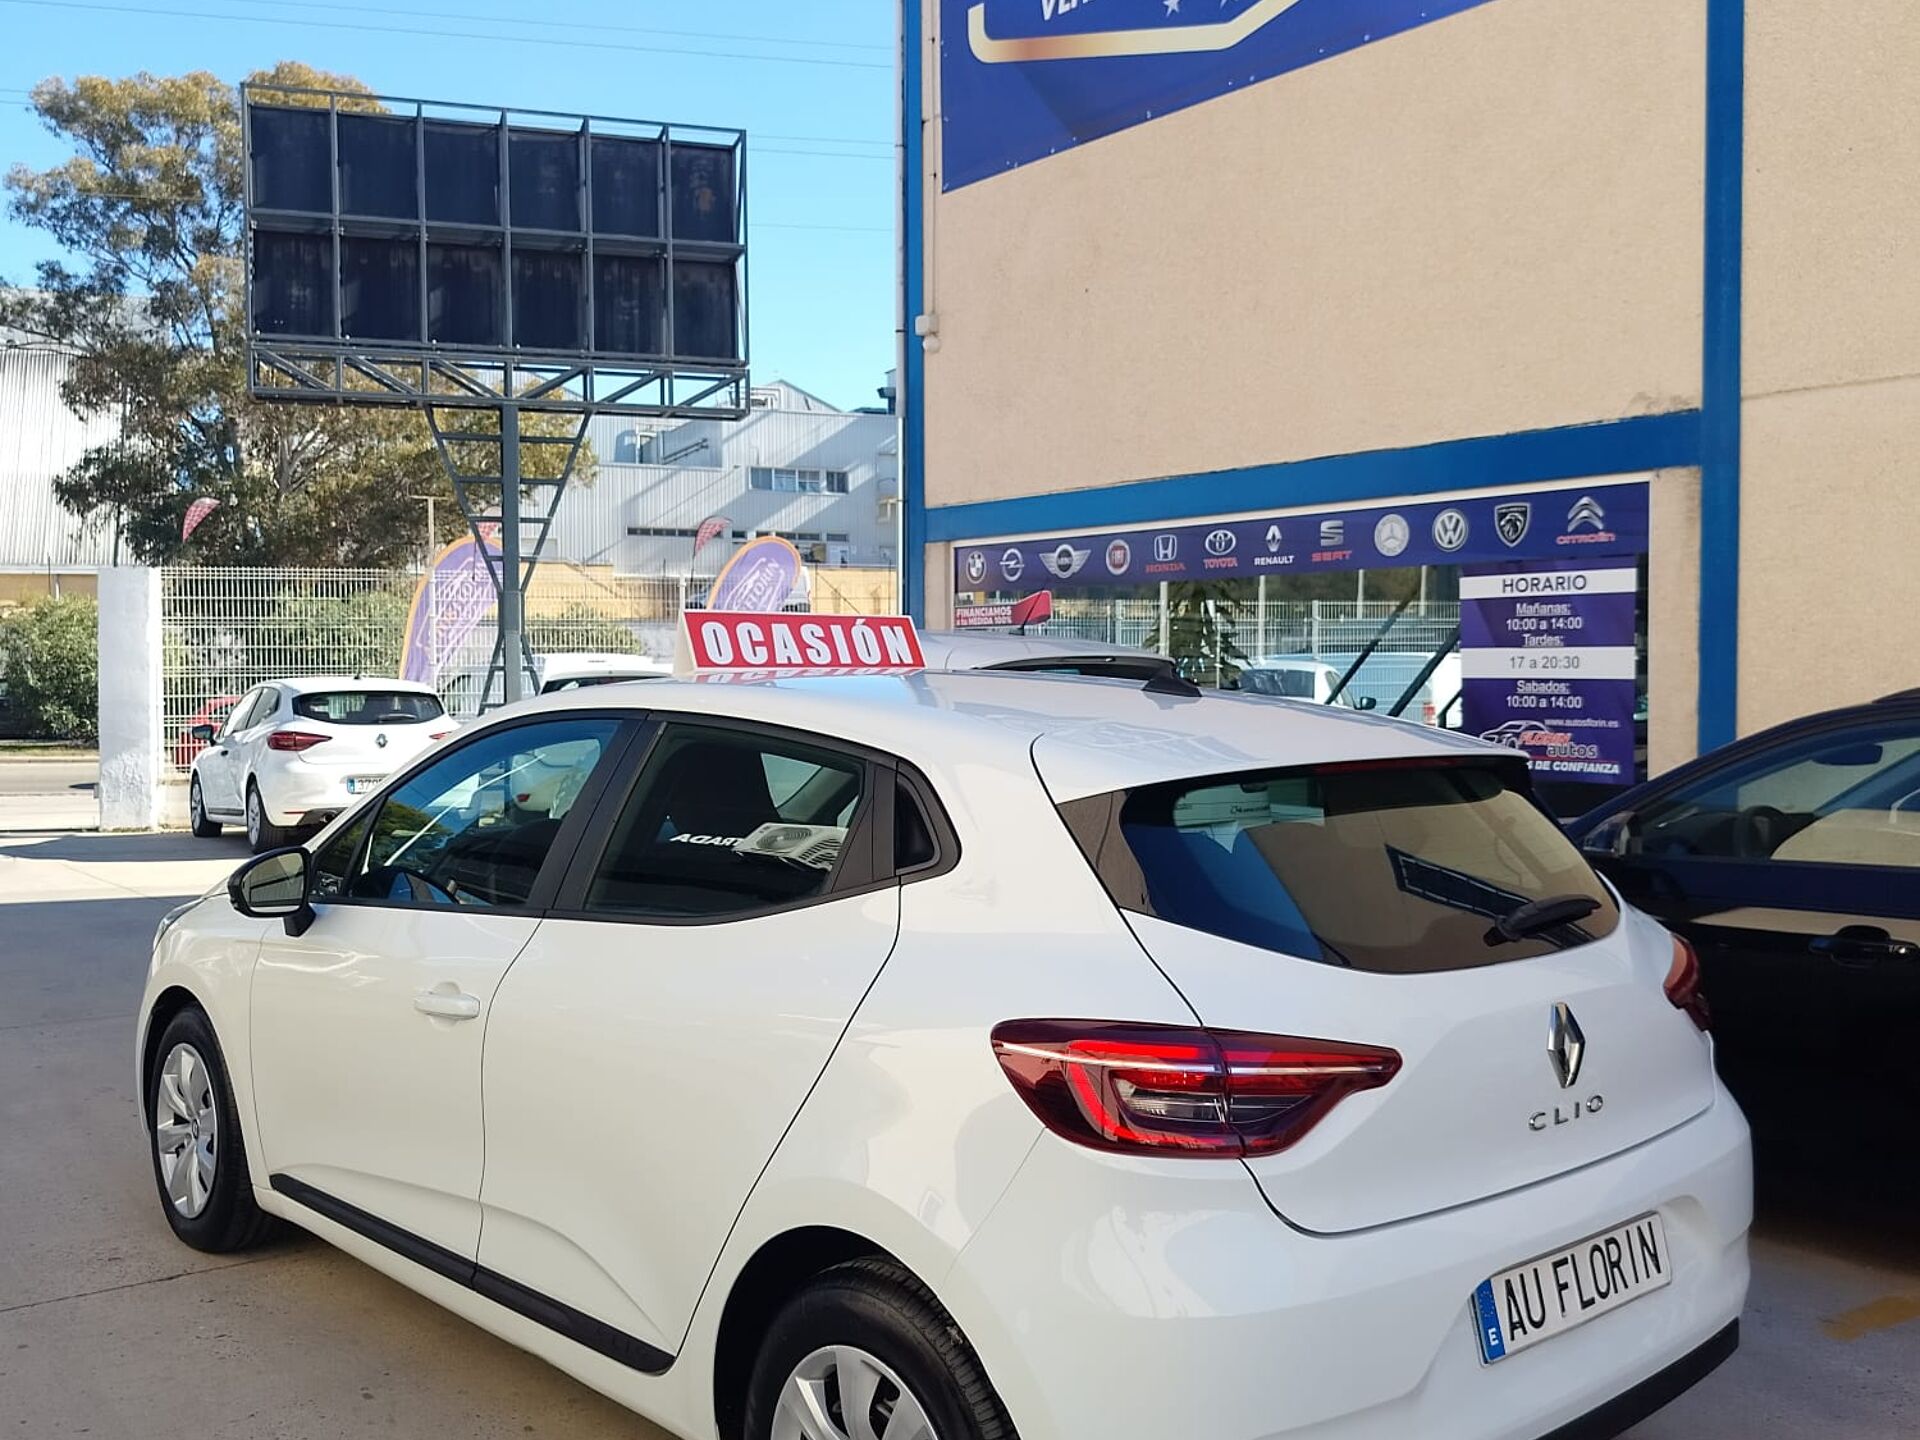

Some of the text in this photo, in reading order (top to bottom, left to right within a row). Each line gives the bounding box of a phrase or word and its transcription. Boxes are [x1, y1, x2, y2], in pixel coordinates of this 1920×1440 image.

[1203, 557, 1238, 569] TOYOTA
[1254, 555, 1295, 566] RENAULT
[1311, 550, 1352, 562] SEAT
[1146, 562, 1186, 573] HONDA
[1502, 574, 1587, 593] HORARIO
[956, 606, 1012, 618] FINANCIAMOS
[1515, 602, 1572, 617] Mañanas:
[1506, 617, 1583, 631] 10:00 a 14:00
[701, 619, 914, 666] OCASIÓN
[1523, 634, 1564, 648] Tardes:
[1510, 656, 1580, 669] 17 a 20:30
[1506, 696, 1582, 709] 10:00 a 14:00
[1546, 742, 1598, 758] autos
[1534, 761, 1550, 770] DE
[1553, 762, 1620, 774] CONFIANZA
[1528, 1095, 1604, 1131] CLIO
[1504, 1221, 1663, 1342] AU FLORIN
[1488, 1327, 1499, 1346] E
